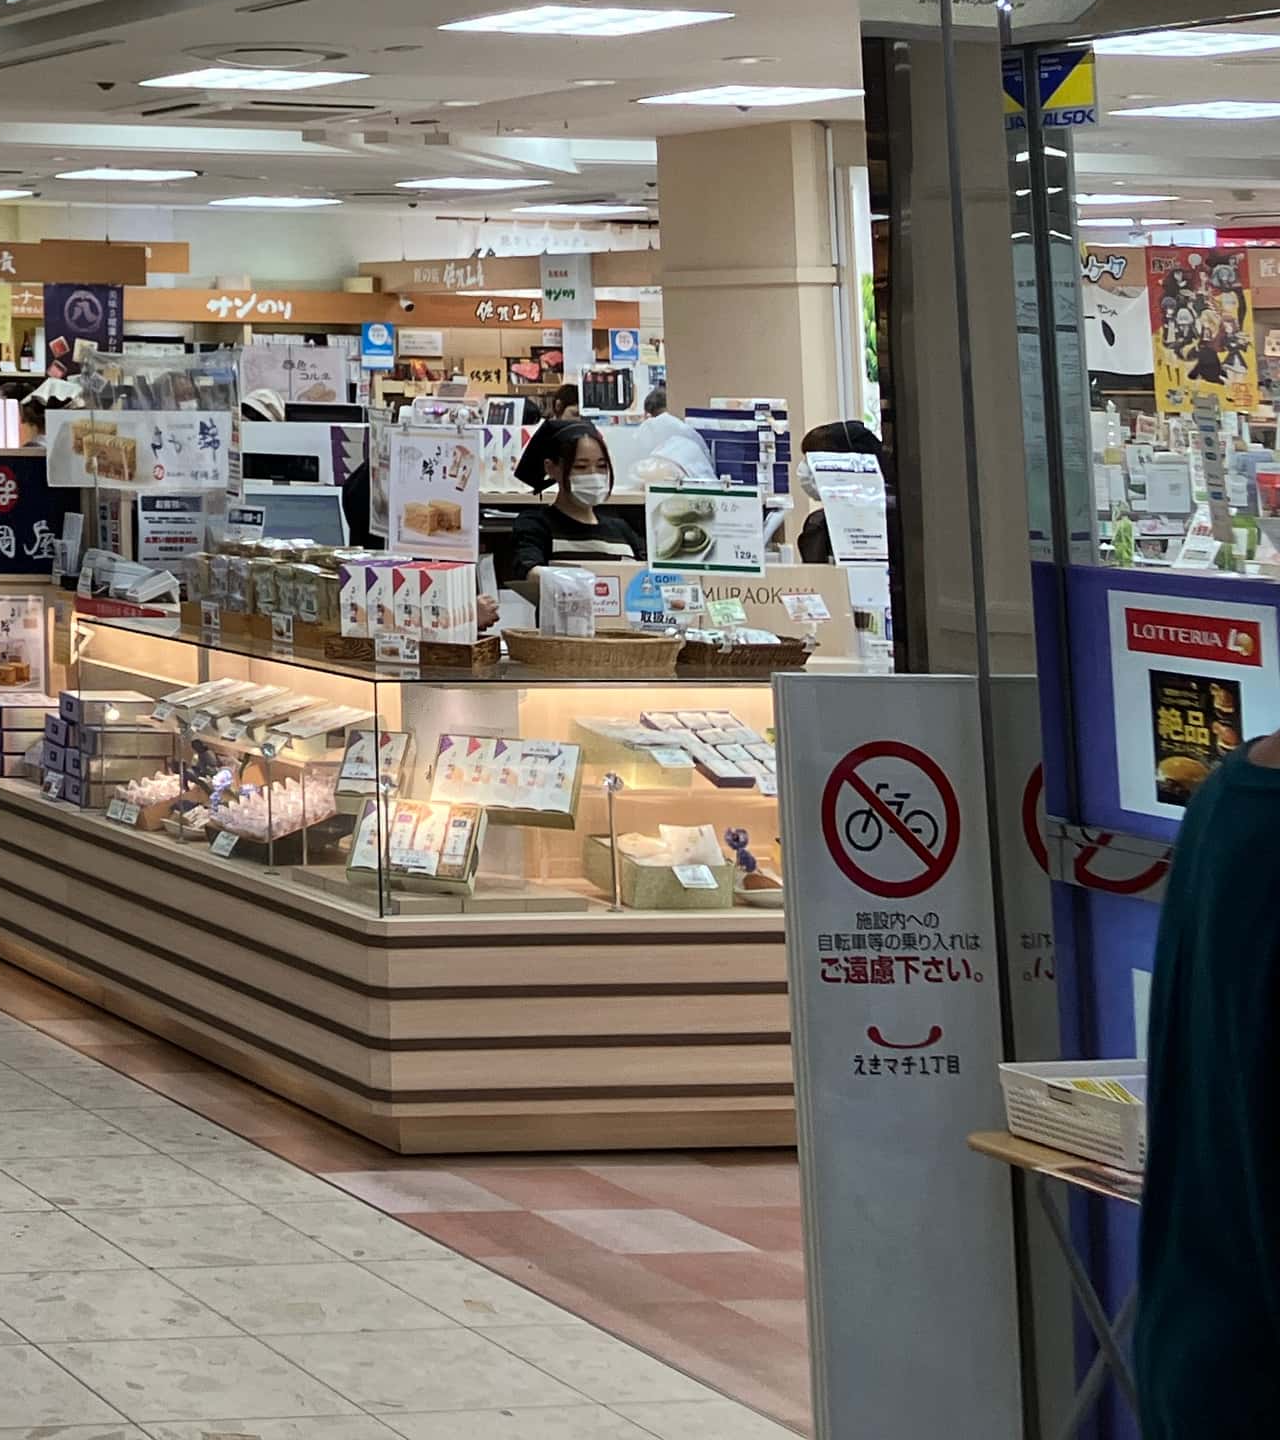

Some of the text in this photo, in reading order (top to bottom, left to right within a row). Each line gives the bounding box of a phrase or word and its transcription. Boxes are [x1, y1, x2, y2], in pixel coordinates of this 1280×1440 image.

[1042, 108, 1095, 126] ALSOK
[1133, 623, 1223, 648] LOTTERIA
[856, 911, 939, 930] 施設内への
[818, 933, 981, 952] 自転車等の乗り入れは
[820, 956, 983, 984] ご遠慮下さい。
[853, 1055, 961, 1075] えきマチ1丁目
